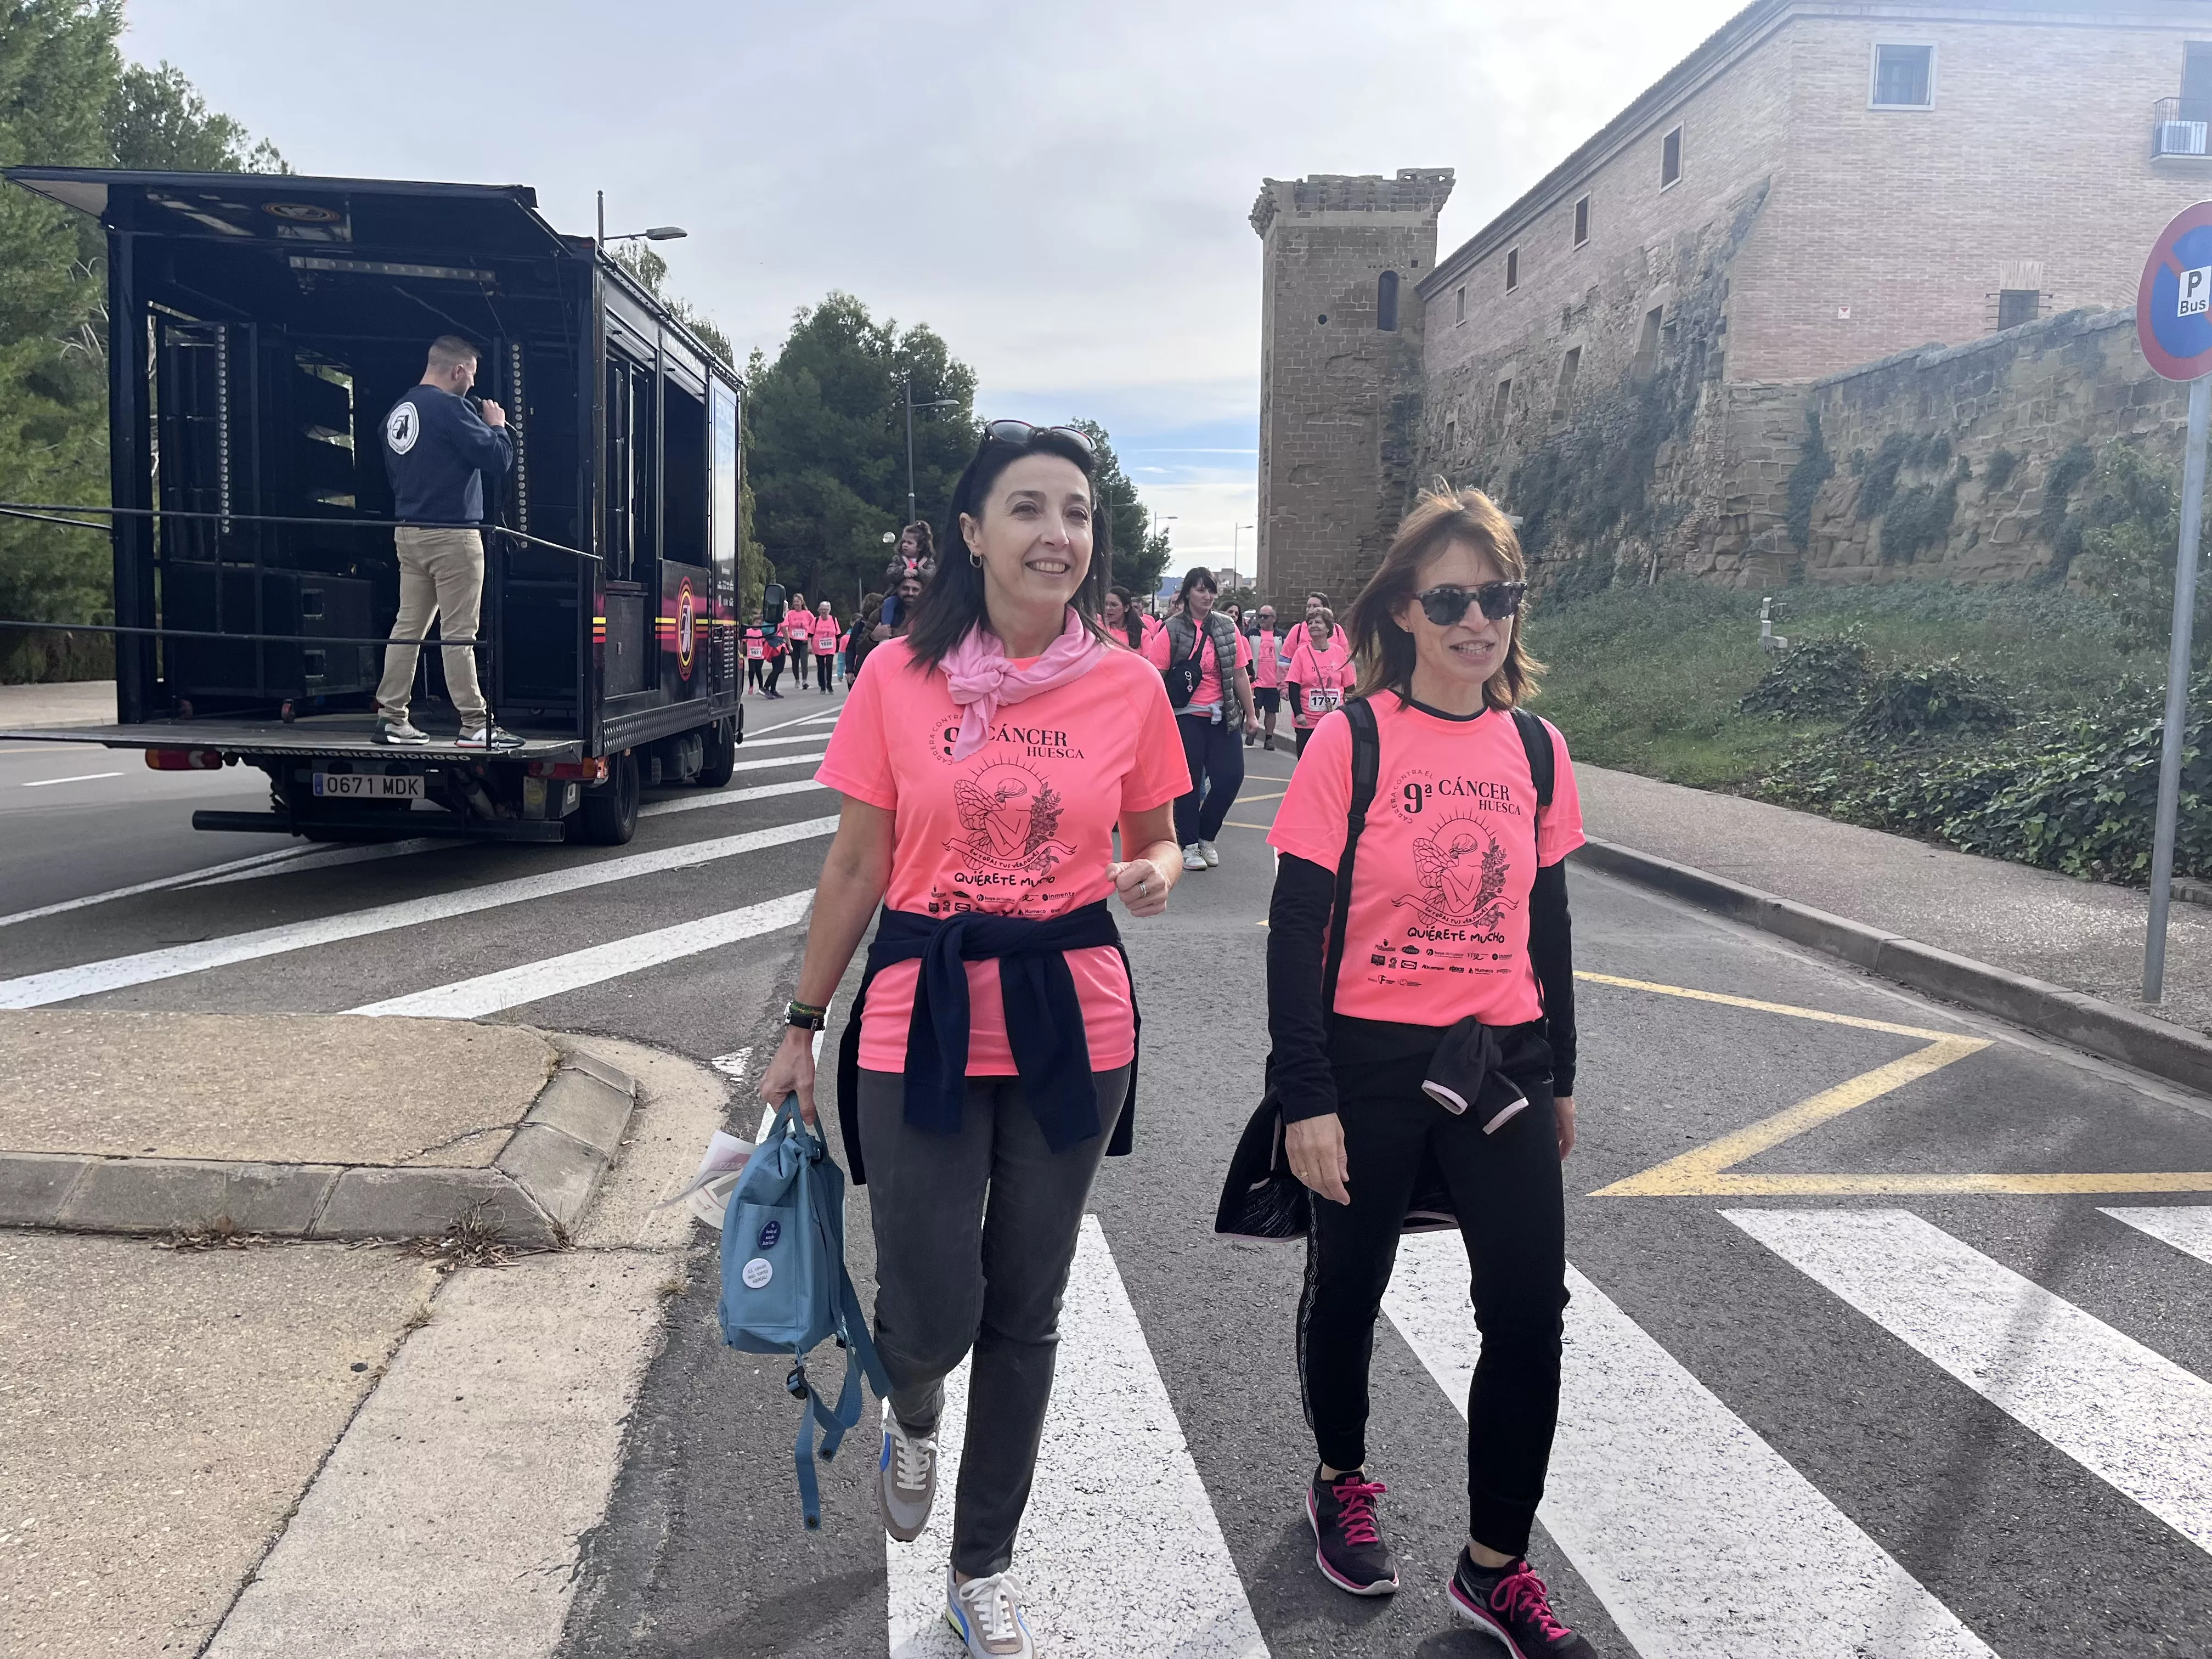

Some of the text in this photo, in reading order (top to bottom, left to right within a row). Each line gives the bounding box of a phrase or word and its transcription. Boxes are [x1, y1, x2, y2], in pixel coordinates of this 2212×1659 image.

[2187, 271, 2202, 298] P
[2180, 300, 2207, 315] Bus
[929, 734, 953, 766] CARRERA
[1026, 746, 1085, 759] HUESCA
[327, 777, 374, 794] 0671
[382, 778, 419, 795] MDK
[1438, 776, 1510, 802] CÁNCER
[1390, 769, 1434, 824] CARRERA CONTRA EL
[1479, 799, 1521, 815] HUESCA
[978, 855, 997, 865] TODAS
[1470, 932, 1505, 944] MUCHO
